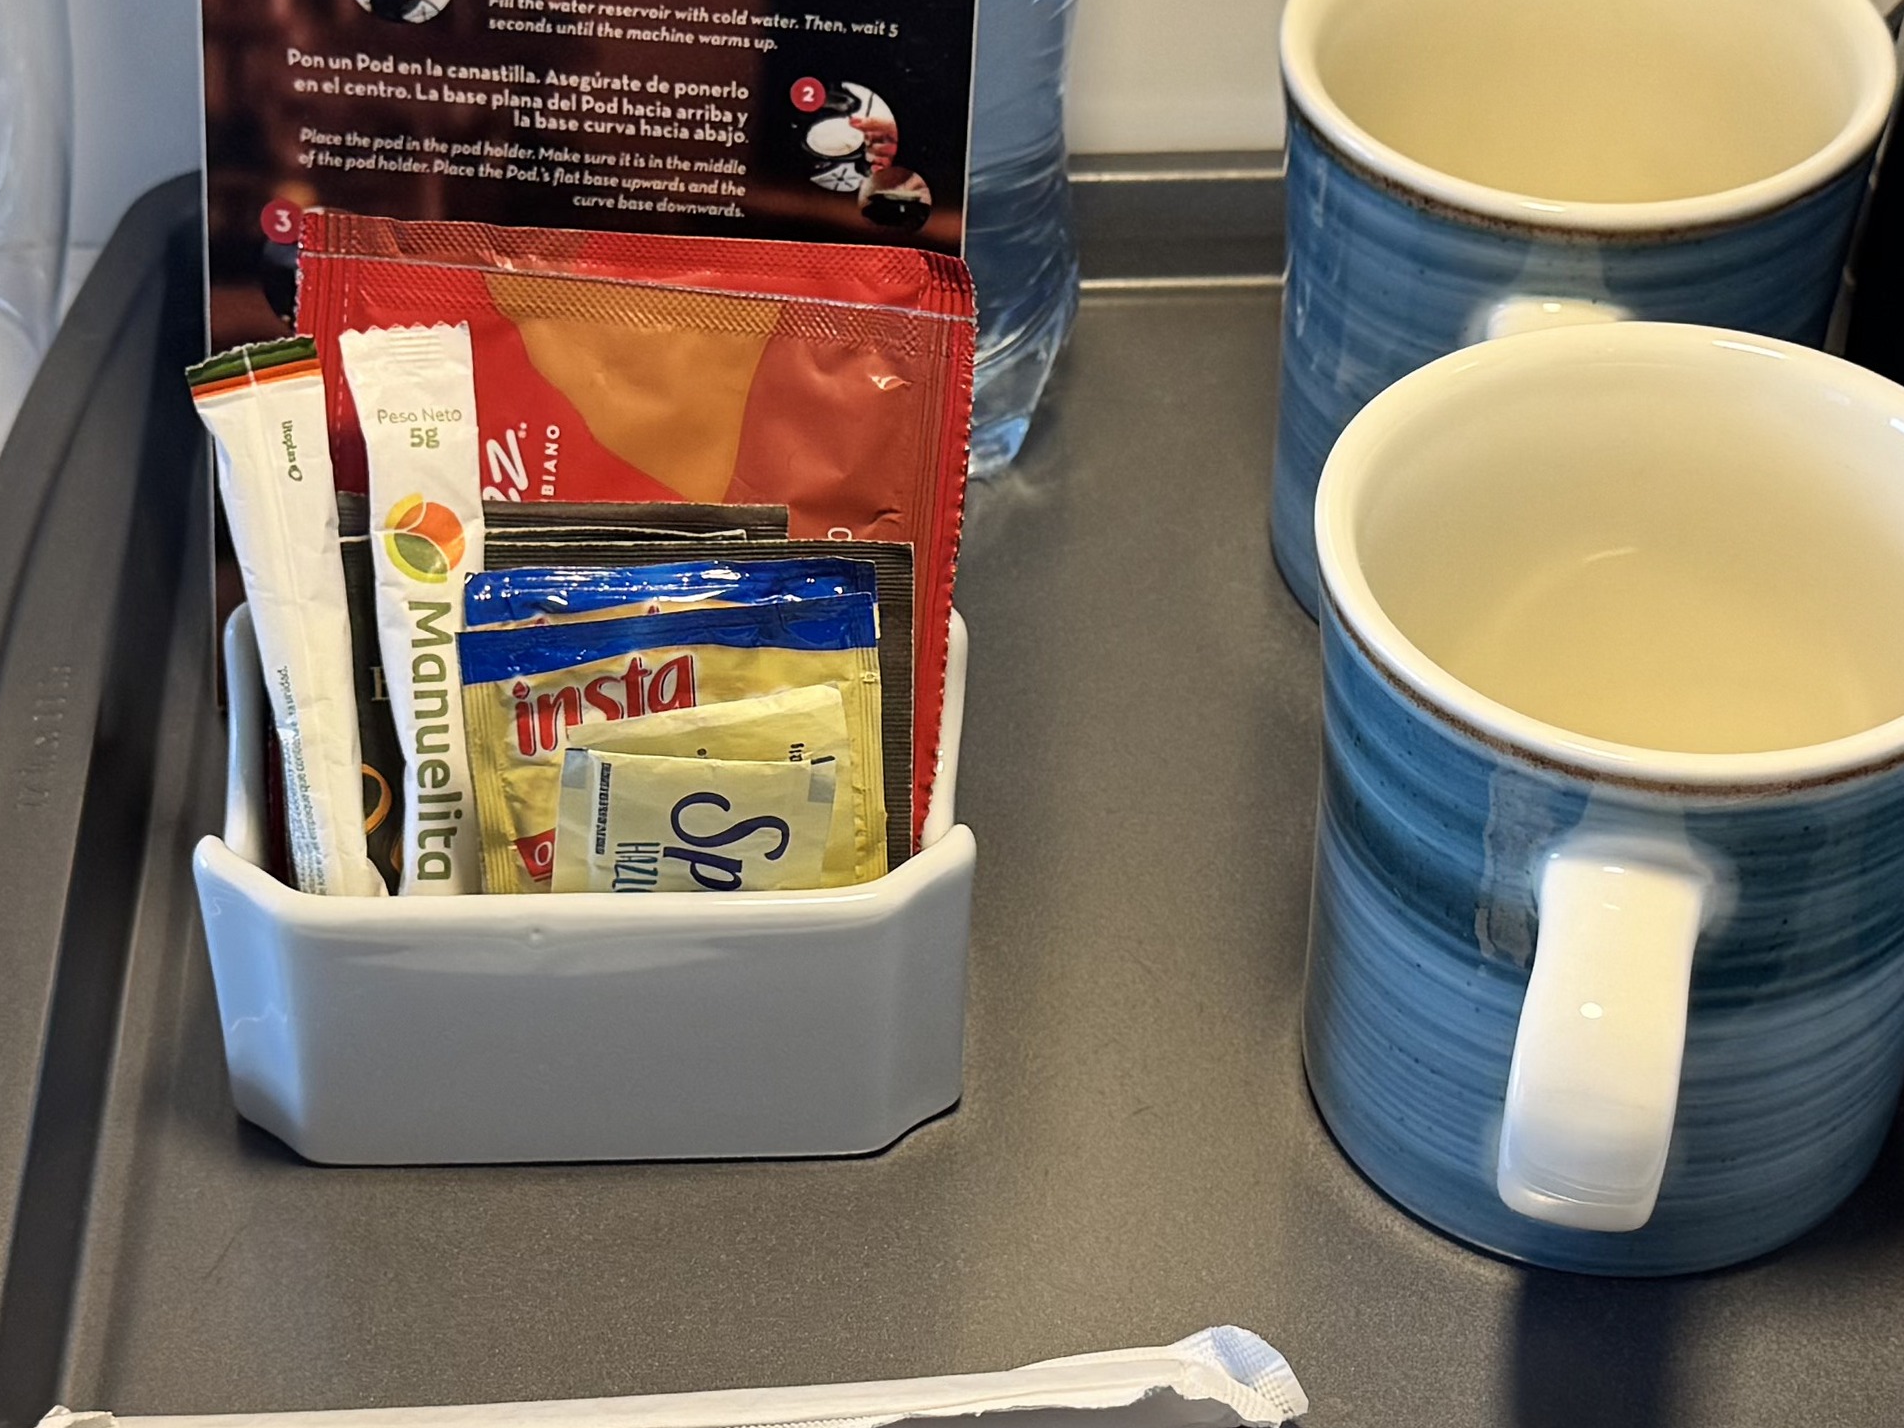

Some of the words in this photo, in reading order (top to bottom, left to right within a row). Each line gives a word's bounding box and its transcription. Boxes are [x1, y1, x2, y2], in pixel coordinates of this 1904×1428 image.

[488, 16, 553, 34] seconds
[556, 20, 595, 37] until
[597, 22, 624, 39] the
[626, 26, 695, 44] machine
[698, 32, 751, 48] warms
[754, 36, 779, 53] up.
[548, 0, 596, 15] water
[598, 4, 672, 20] reservoir
[674, 7, 709, 23] with
[712, 9, 748, 25] cold
[751, 13, 799, 29] water.
[804, 14, 847, 33] Then,
[850, 19, 886, 36] wait
[888, 23, 899, 38] 5
[287, 47, 325, 68] Pon
[328, 56, 352, 71] un
[356, 52, 394, 73] Pod
[397, 61, 422, 76] en
[425, 57, 443, 77] la
[446, 63, 541, 84] canastilla.
[545, 68, 642, 92] Asegúrate
[646, 74, 670, 93] de
[674, 80, 750, 100] ponerlo
[802, 86, 815, 103] 2
[293, 78, 319, 93] en
[322, 76, 340, 94] el
[344, 80, 412, 100] centro.
[415, 83, 439, 102] La
[443, 84, 488, 105] base
[491, 88, 543, 110] plana
[547, 92, 576, 111] del
[581, 96, 618, 115] Pod
[622, 98, 672, 119] hacia
[676, 104, 733, 123] arriba
[737, 111, 748, 128] y
[513, 109, 531, 128] la
[534, 109, 579, 132] base
[583, 119, 636, 136] curva
[640, 118, 690, 140] hacia
[693, 123, 750, 147] abajo.
[299, 126, 342, 146] Place
[345, 131, 371, 148] the
[373, 135, 404, 152] pod
[406, 135, 420, 152] in
[423, 137, 448, 154] the
[451, 140, 482, 158] pod
[483, 142, 536, 160] holder.
[539, 147, 581, 163] Make
[584, 153, 616, 166] sure
[619, 152, 631, 167] it
[633, 152, 646, 167] is
[648, 153, 663, 170] in
[665, 154, 691, 172] the
[693, 159, 747, 175] middle
[298, 150, 316, 168] of
[317, 150, 343, 168] the
[344, 155, 376, 171] pod
[378, 155, 431, 173] holder.
[432, 159, 475, 177] Place
[477, 162, 503, 179] the
[552, 167, 581, 186] flat
[582, 170, 619, 188] base
[621, 175, 686, 192] upwards
[688, 179, 718, 194] and
[720, 180, 746, 197] the
[274, 209, 292, 233] 3
[572, 194, 615, 209] curve
[617, 194, 654, 211] base
[656, 197, 745, 218] downwards.
[377, 409, 418, 424] Peso
[422, 407, 462, 422] Neto
[410, 426, 441, 449] 5g
[540, 425, 560, 499] BIANO
[408, 600, 463, 881] Manuelita
[662, 791, 790, 892] Sp
[611, 841, 661, 892] HAZL
